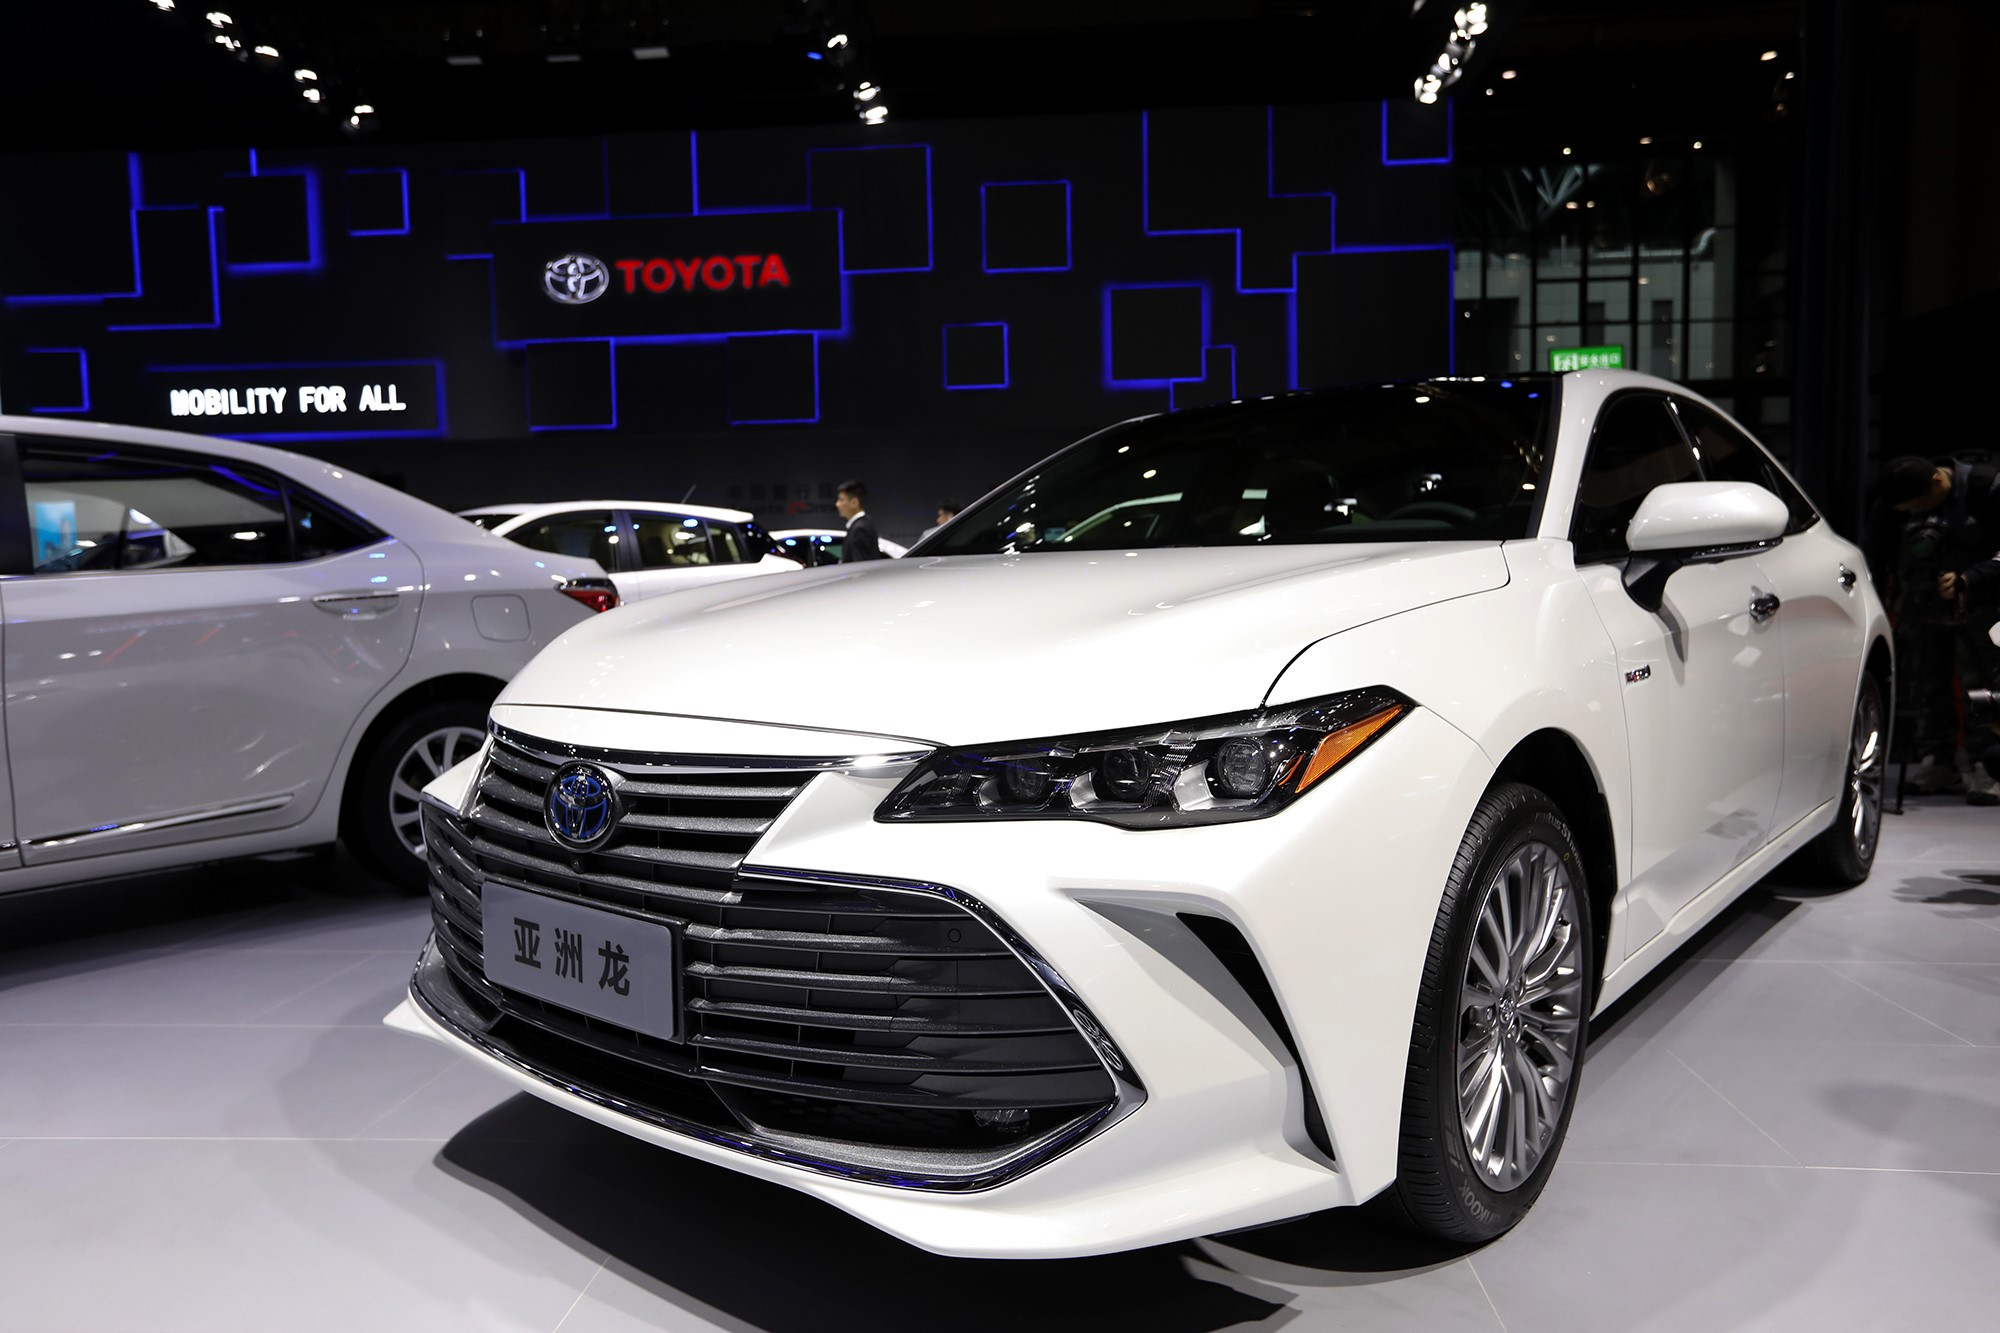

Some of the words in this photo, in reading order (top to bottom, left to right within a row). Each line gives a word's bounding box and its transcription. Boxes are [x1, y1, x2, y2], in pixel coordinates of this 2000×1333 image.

[615, 253, 790, 294] TOYOTA
[170, 387, 287, 416] MOBILITY
[299, 385, 347, 413] FOR
[359, 384, 407, 412] ALL
[513, 917, 631, 997] 亚洲龙
